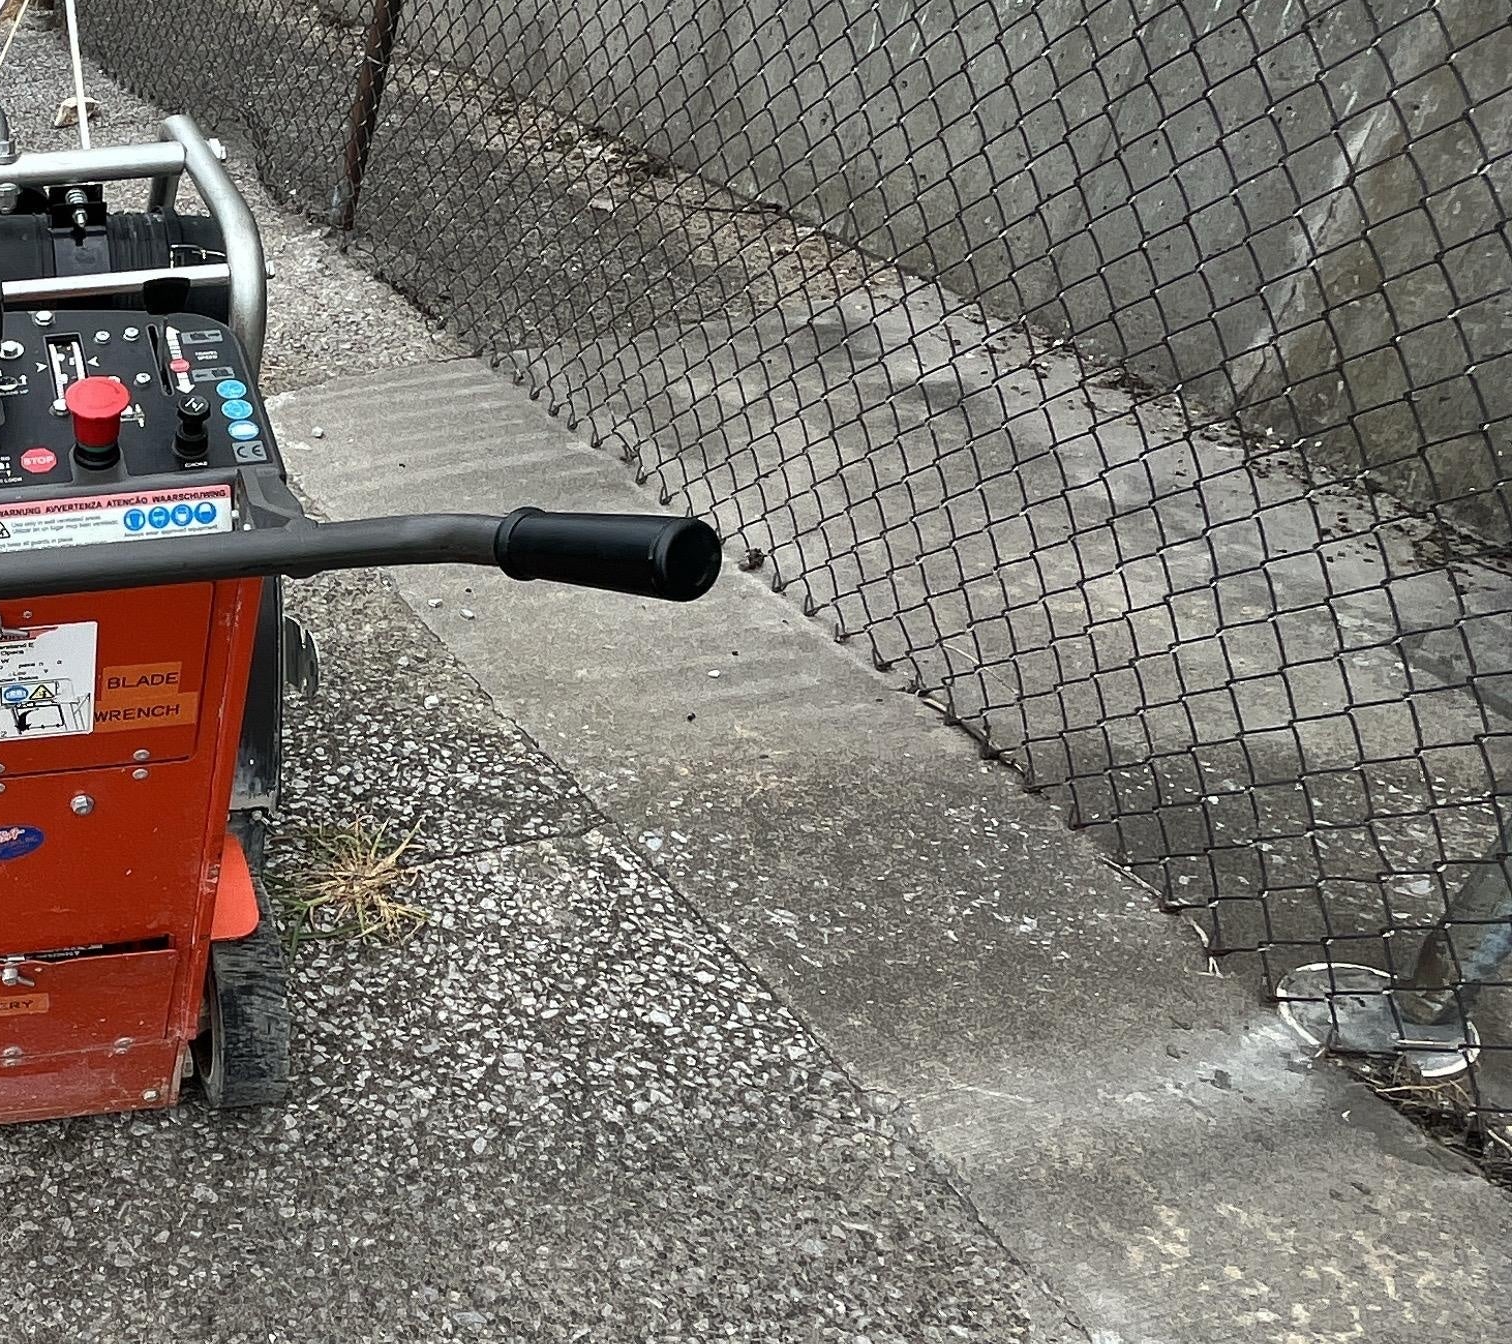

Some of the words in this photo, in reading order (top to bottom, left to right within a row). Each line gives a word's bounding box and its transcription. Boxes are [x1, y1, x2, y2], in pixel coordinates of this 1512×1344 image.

[236, 445, 263, 459] CE
[22, 456, 56, 467] STOP
[45, 502, 102, 514] AVVERTENZA
[152, 489, 226, 504] WAARSCHUWING
[107, 672, 179, 690] BLADE
[94, 704, 180, 723] WRENCH
